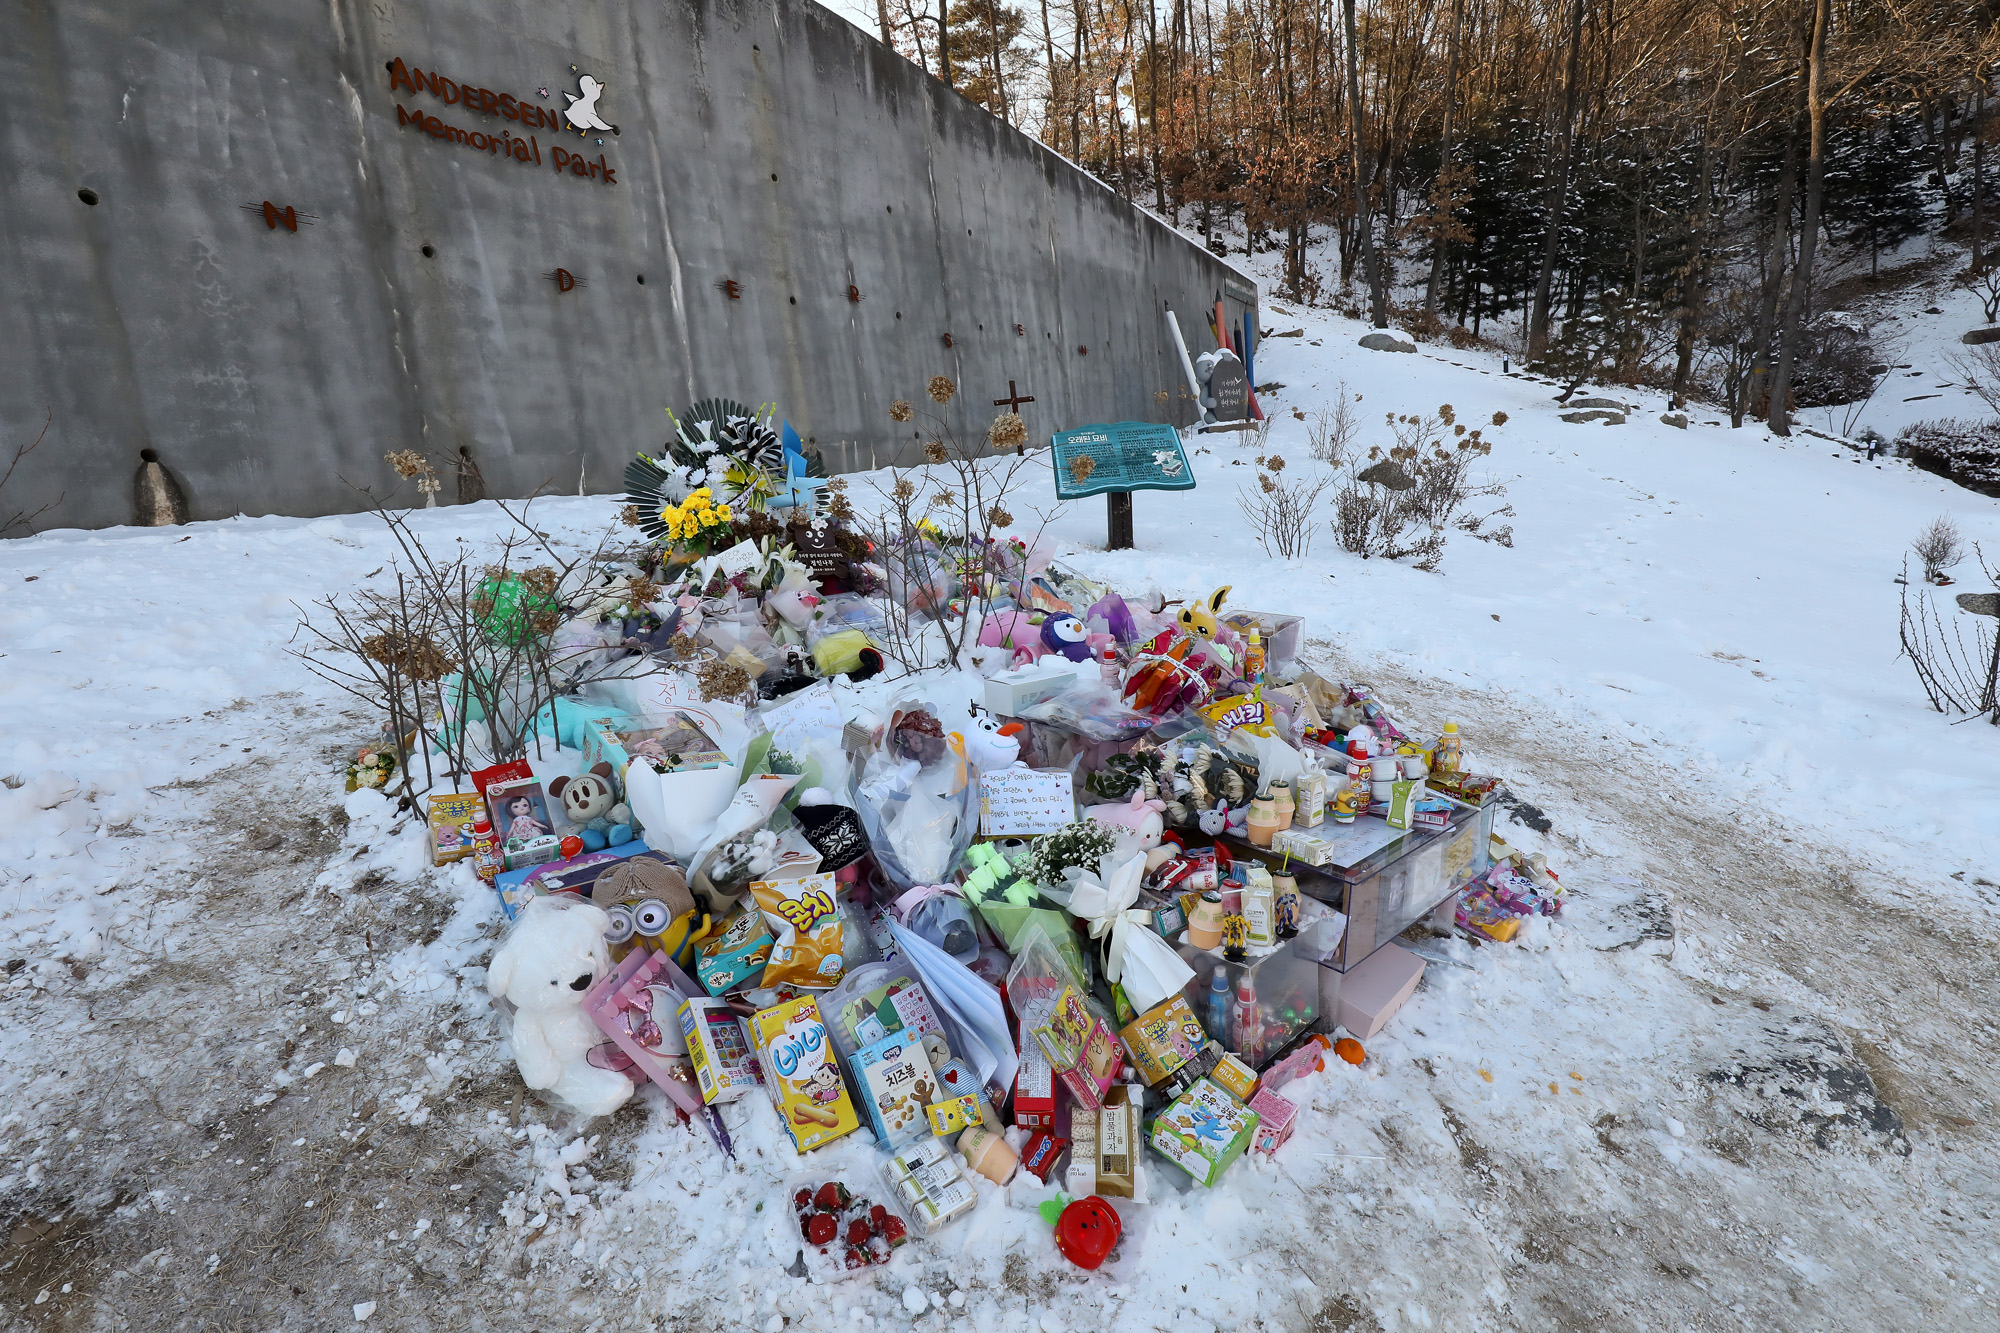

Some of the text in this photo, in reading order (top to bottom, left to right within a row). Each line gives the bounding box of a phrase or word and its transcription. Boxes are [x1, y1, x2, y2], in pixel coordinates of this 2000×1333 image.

[391, 57, 559, 132] ANDERSEN
[397, 104, 617, 184] Memorial Park
[263, 201, 297, 232] N
[557, 268, 575, 292] D
[727, 279, 740, 299] E
[777, 890, 836, 933] 콘치
[731, 1076, 754, 1086] 스마트폰
[886, 1062, 917, 1087] 치즈볼
[1219, 1066, 1237, 1084] 바나나
[1028, 1135, 1052, 1167] 오예스
[1106, 1111, 1117, 1153] 밥풀과자
